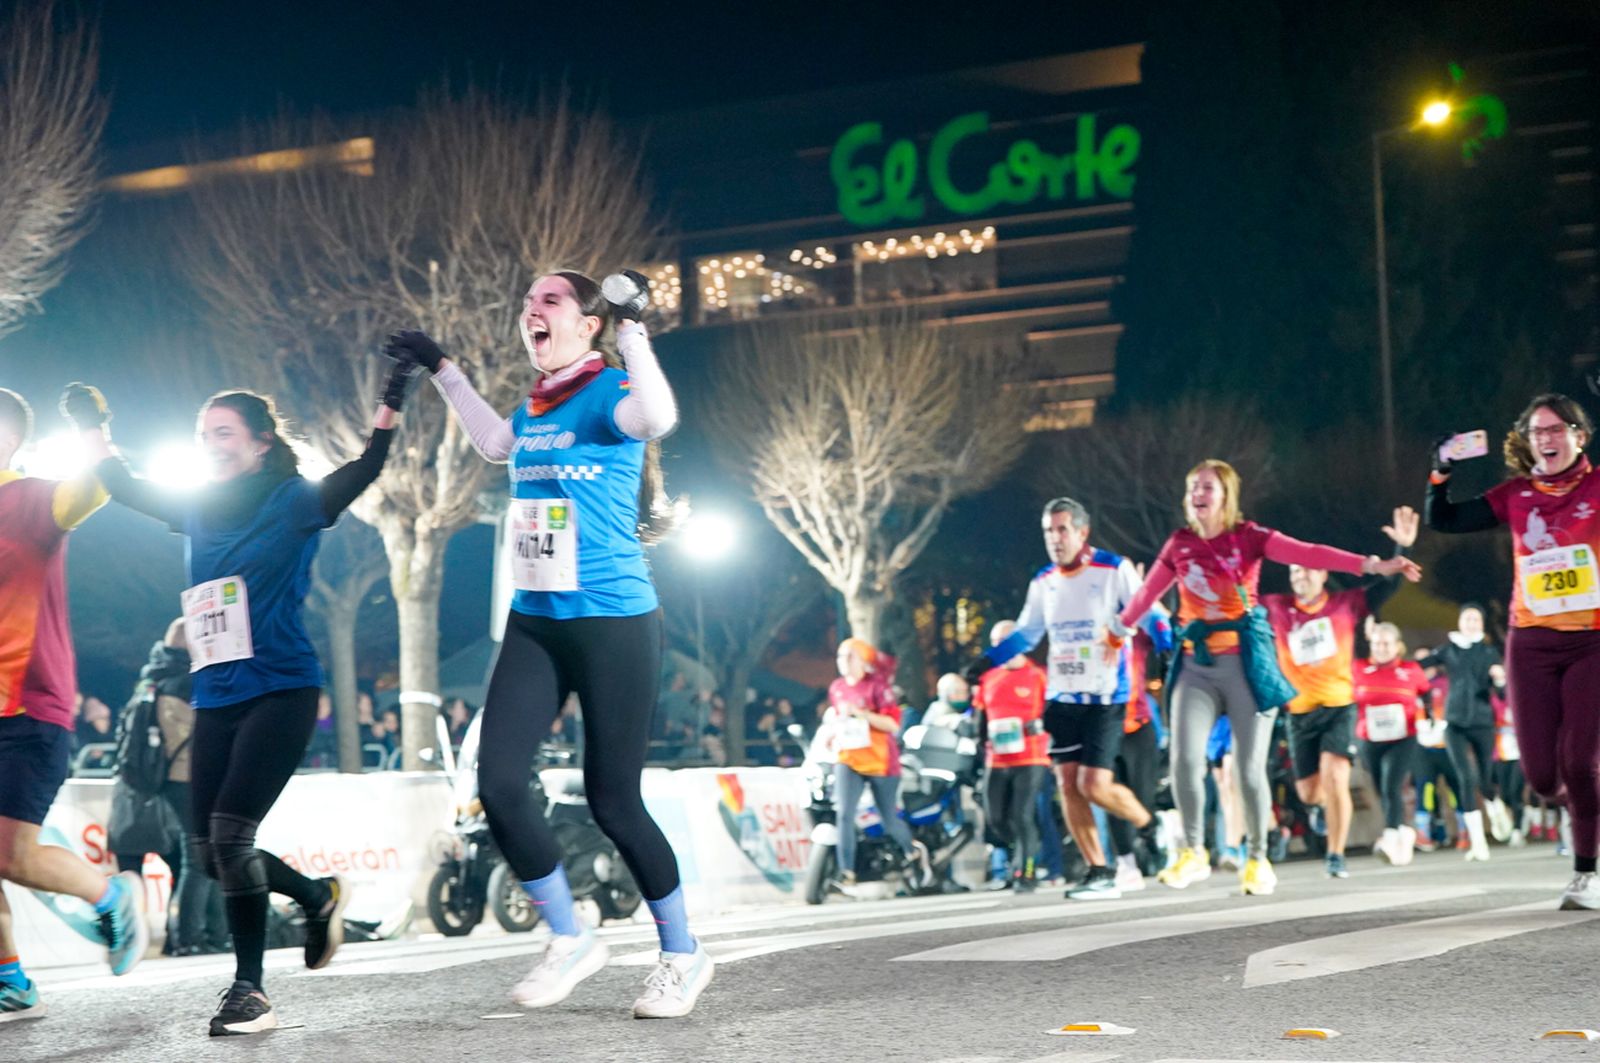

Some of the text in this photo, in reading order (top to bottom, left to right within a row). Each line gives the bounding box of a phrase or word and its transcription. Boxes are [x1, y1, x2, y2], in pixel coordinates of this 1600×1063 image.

[830, 110, 1142, 226] El Corte
[1541, 569, 1578, 592] 230
[280, 841, 401, 873] alderón
[775, 838, 810, 869] ANT
